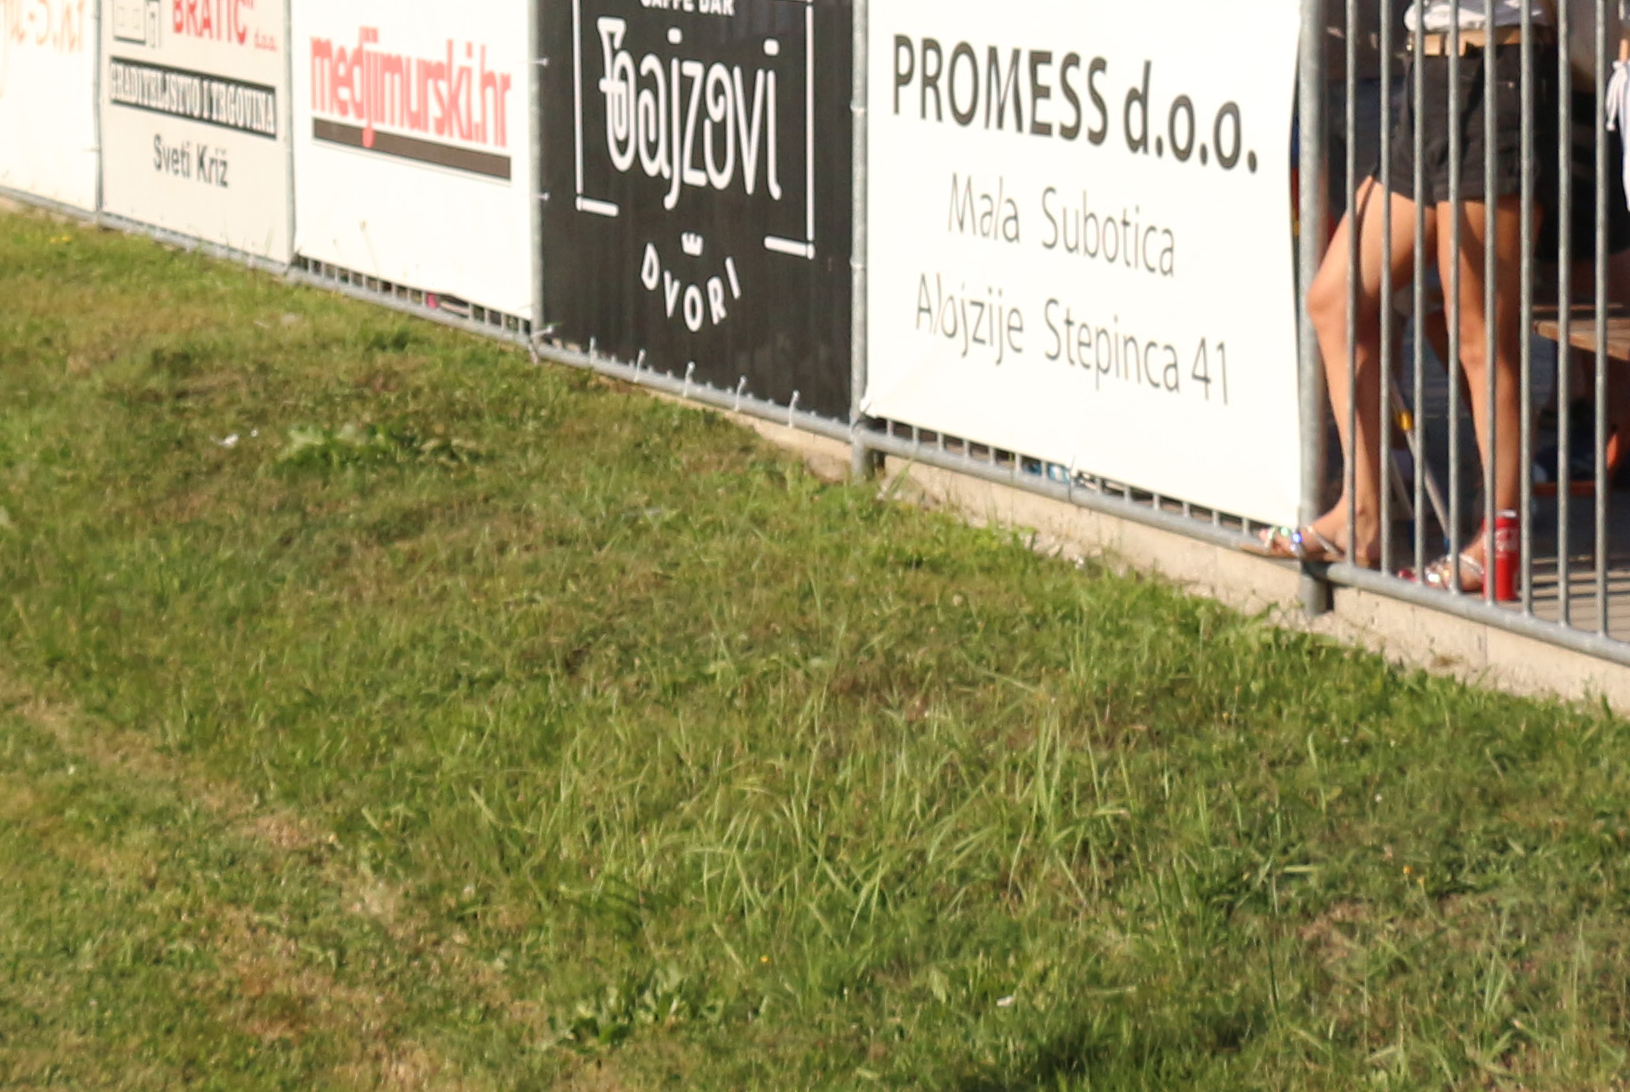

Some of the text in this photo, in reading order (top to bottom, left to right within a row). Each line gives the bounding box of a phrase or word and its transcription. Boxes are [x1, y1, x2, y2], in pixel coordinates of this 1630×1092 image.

[310, 25, 512, 149] medjimurski.hr
[892, 33, 1259, 176] PROMESS d.o.o.
[153, 132, 229, 189] Sveti Križ
[947, 171, 1176, 277] Mala Subotica
[640, 241, 742, 333] DVORI
[914, 271, 1229, 407] Alojzije Stepinca 41
